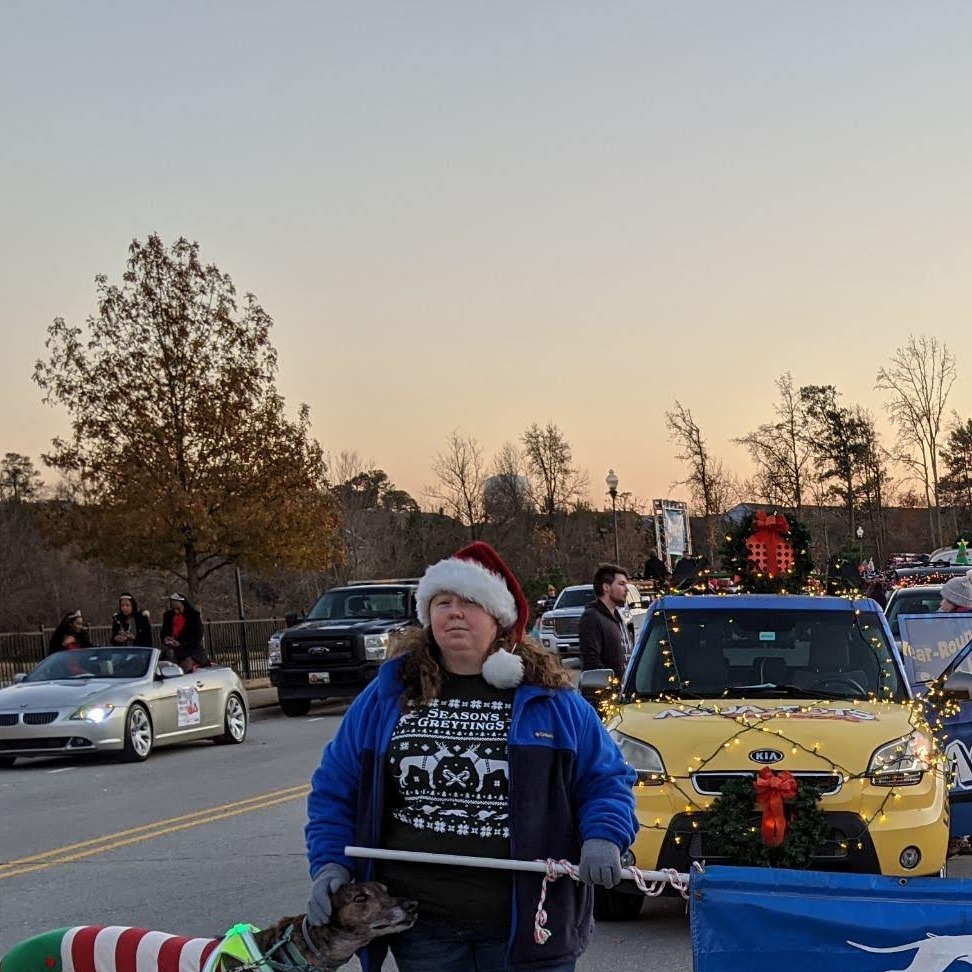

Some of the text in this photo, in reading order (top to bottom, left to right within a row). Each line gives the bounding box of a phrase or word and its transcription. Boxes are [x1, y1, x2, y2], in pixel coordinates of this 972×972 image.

[427, 708, 500, 721] SEASON'S
[417, 717, 505, 731] GREYTINGS
[755, 752, 779, 762] KIA
